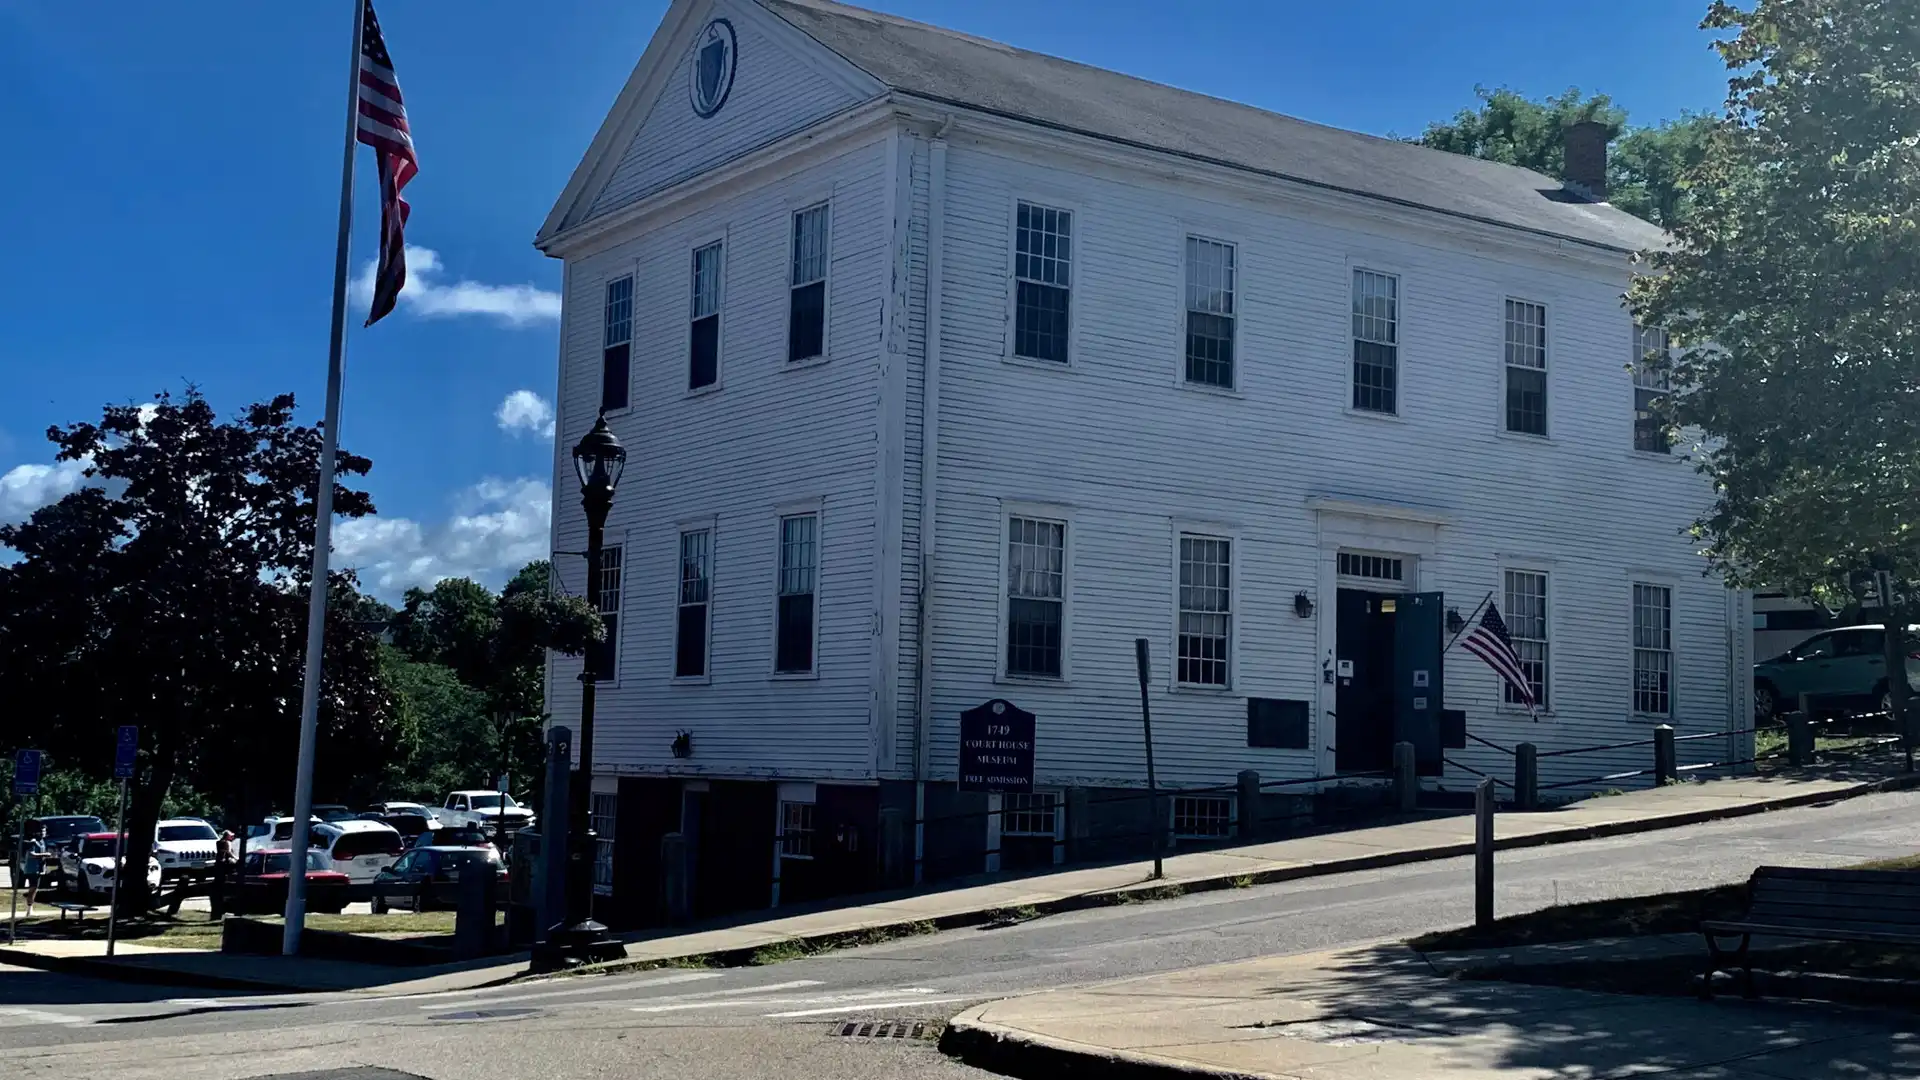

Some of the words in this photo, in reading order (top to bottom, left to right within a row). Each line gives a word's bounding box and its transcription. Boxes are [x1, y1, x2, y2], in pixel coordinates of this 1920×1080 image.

[987, 724, 1010, 736] 1749
[977, 755, 1017, 765] MUSEUM
[965, 775, 984, 783] FREE
[987, 775, 1029, 785] ADMISSION
